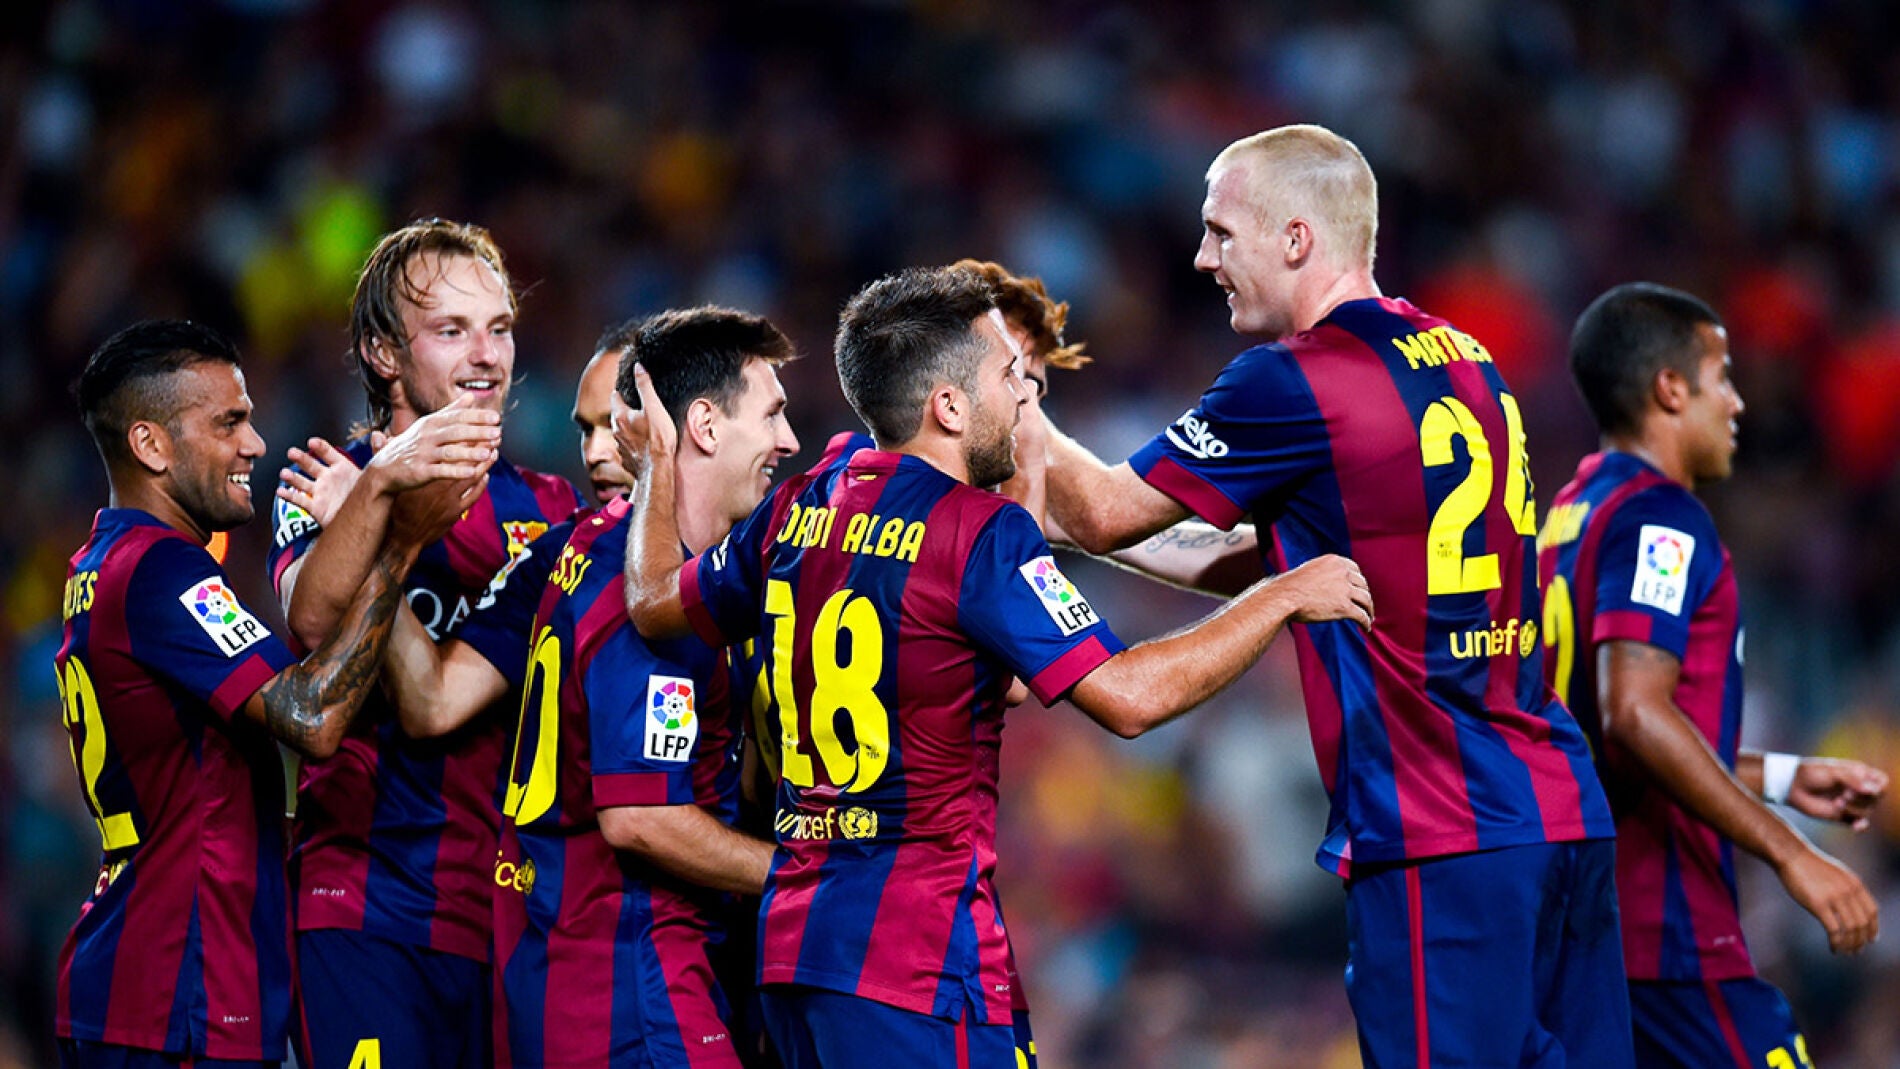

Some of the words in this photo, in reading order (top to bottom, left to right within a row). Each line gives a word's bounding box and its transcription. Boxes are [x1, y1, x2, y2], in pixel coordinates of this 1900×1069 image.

[841, 512, 927, 563] ALBA
[1057, 601, 1092, 631] LFP
[221, 619, 257, 651] LFP
[765, 579, 890, 793] 18
[650, 732, 690, 759] LFP
